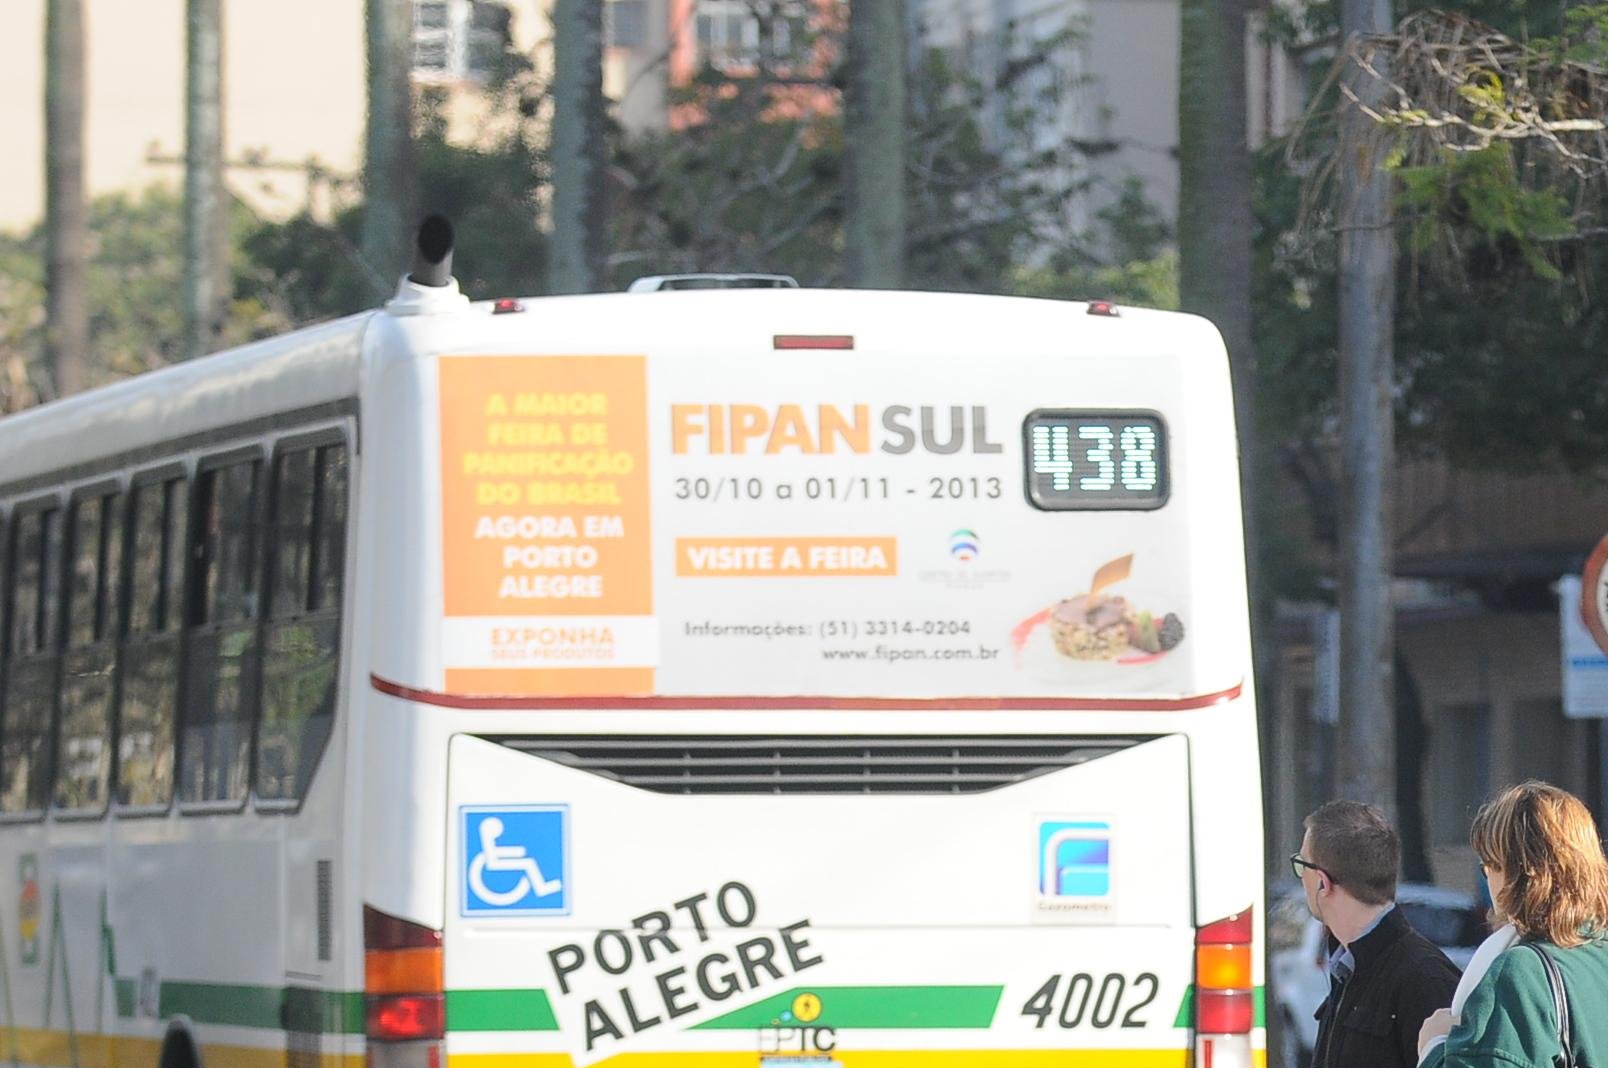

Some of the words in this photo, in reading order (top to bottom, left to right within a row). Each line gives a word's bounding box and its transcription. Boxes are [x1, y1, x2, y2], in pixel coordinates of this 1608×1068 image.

[486, 393, 507, 415] A
[513, 393, 607, 415] MAIOR
[487, 422, 564, 445] FEIRA
[571, 422, 607, 445] DE
[671, 404, 871, 455] FIPAN
[880, 404, 1004, 455] SUL
[463, 446, 634, 479] PANIFICAÇÃO
[1033, 426, 1157, 491] 438
[475, 481, 521, 505] DO
[528, 481, 622, 505] BRASIL
[675, 477, 763, 502] 30/10
[775, 482, 793, 500] a
[806, 477, 889, 502] 01/11
[929, 477, 1002, 500] 2013
[475, 515, 577, 539] AGORA
[584, 515, 624, 538] EM
[503, 545, 598, 569] PORTO
[687, 546, 773, 570] VISITE
[781, 546, 801, 570] A
[810, 546, 888, 569] FEIRA
[498, 574, 603, 599] ALEGRE
[491, 627, 615, 646] EXPONHA
[818, 619, 860, 638] (51)
[866, 619, 971, 637] 3314-0204
[821, 644, 1000, 663] www.fipan.com.br
[547, 881, 757, 995] PORTO
[584, 920, 824, 1052] ALEGRE
[1020, 972, 1159, 1029] 4002
[758, 1026, 837, 1054] EPTC
